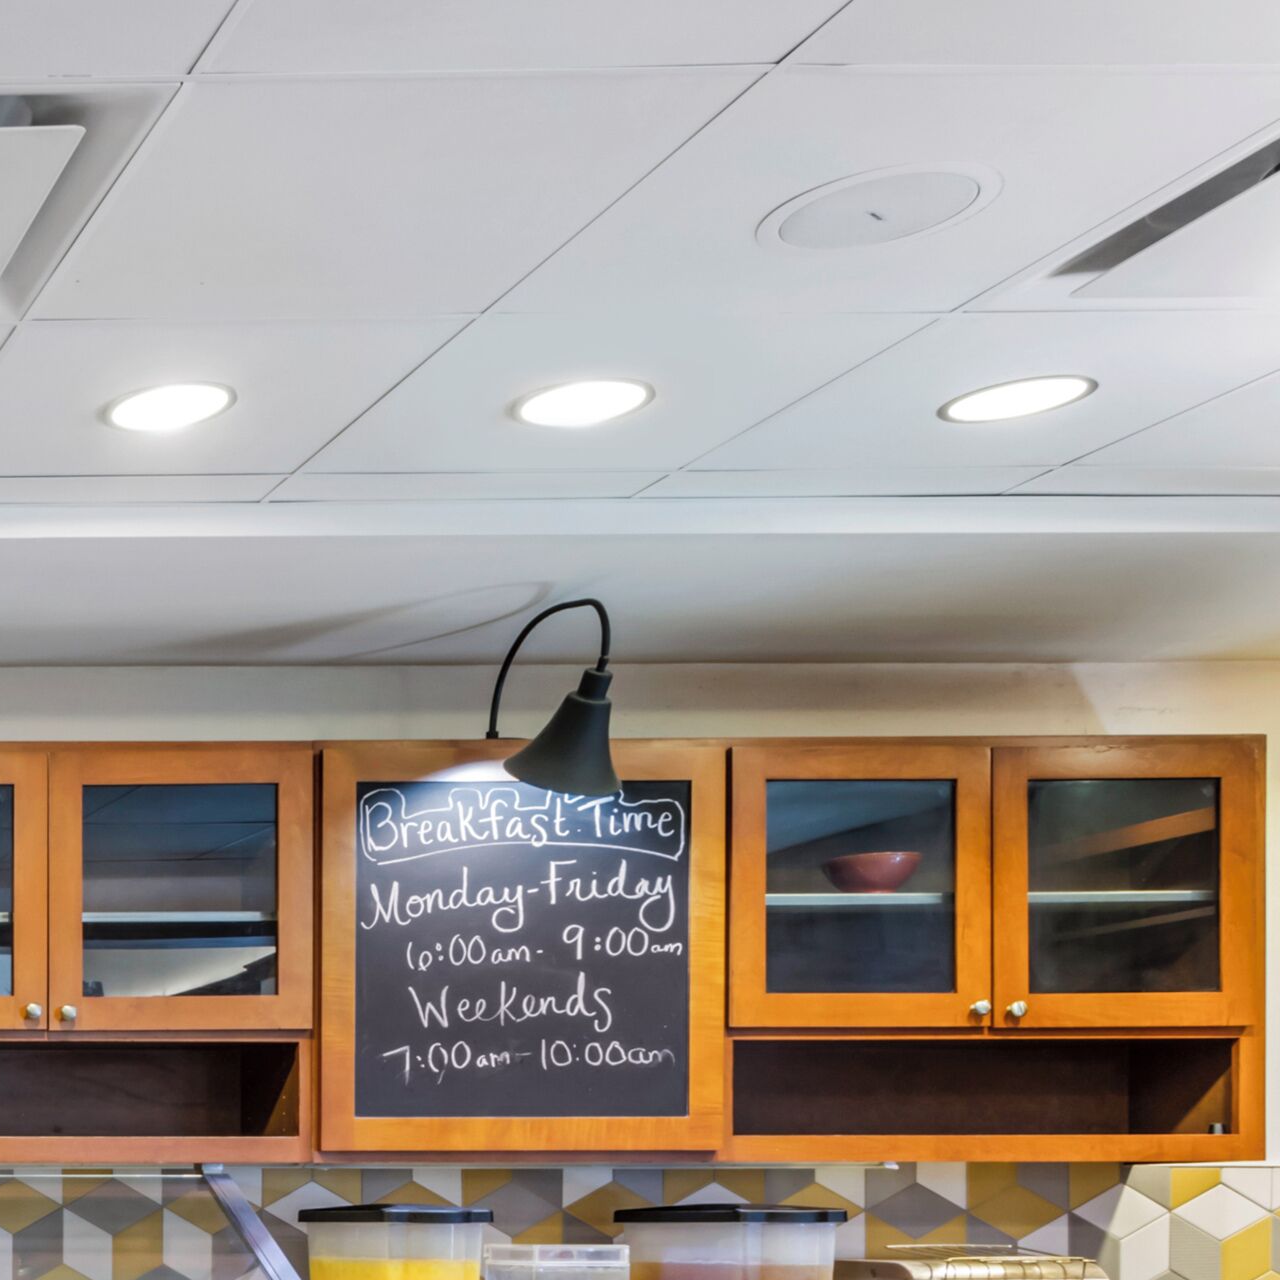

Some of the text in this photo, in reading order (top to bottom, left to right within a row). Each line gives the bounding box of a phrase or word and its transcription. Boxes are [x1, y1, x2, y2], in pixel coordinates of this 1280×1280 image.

[364, 795, 675, 852] Breakfast Time
[407, 971, 613, 1033] Weekends
